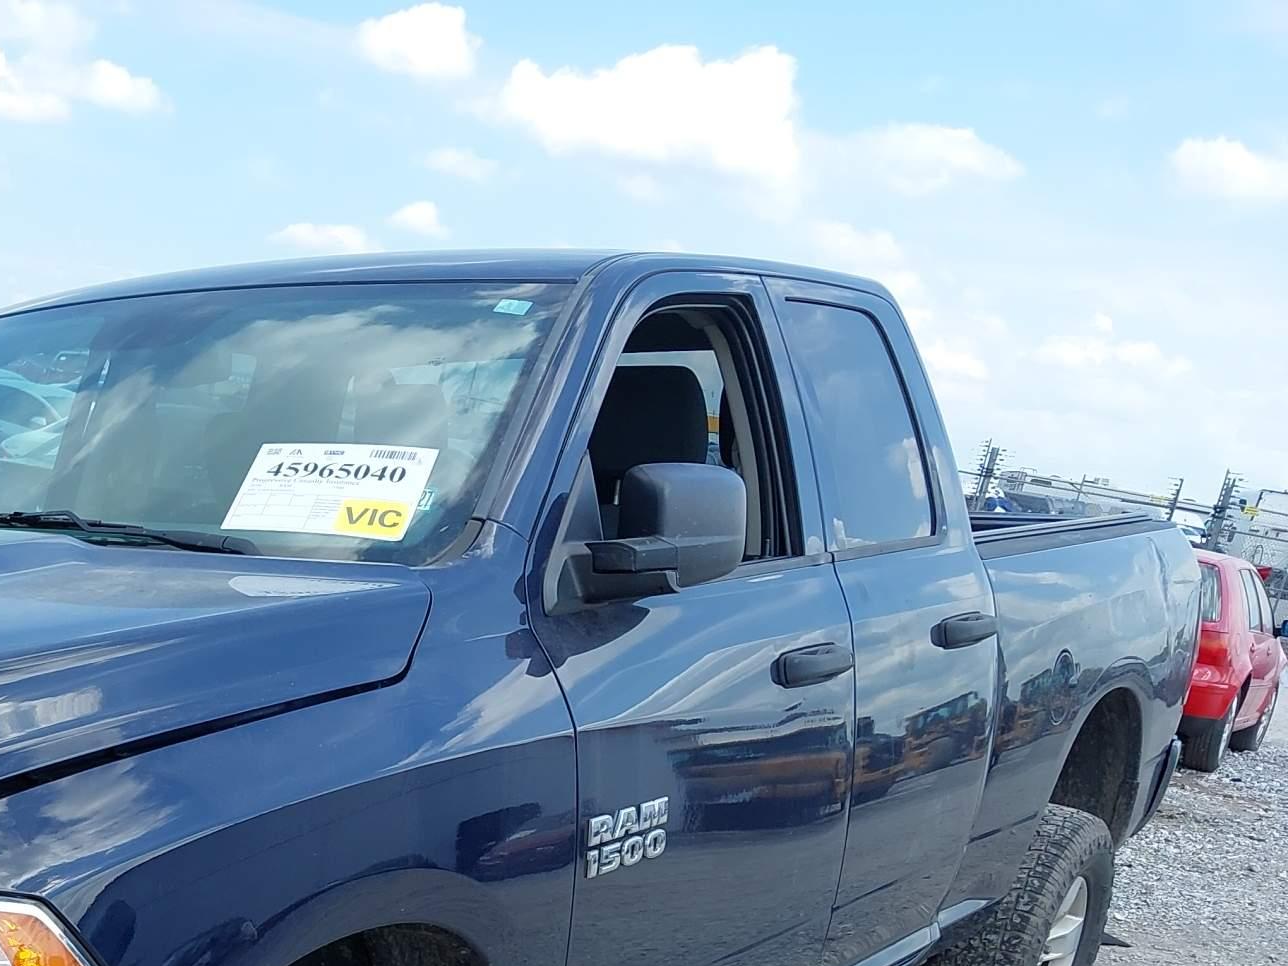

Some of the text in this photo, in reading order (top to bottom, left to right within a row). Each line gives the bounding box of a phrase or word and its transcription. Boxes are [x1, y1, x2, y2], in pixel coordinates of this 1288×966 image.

[266, 461, 407, 484] 45965040
[345, 506, 403, 529] VIC
[587, 796, 669, 847] RAM
[586, 828, 667, 879] 1500
